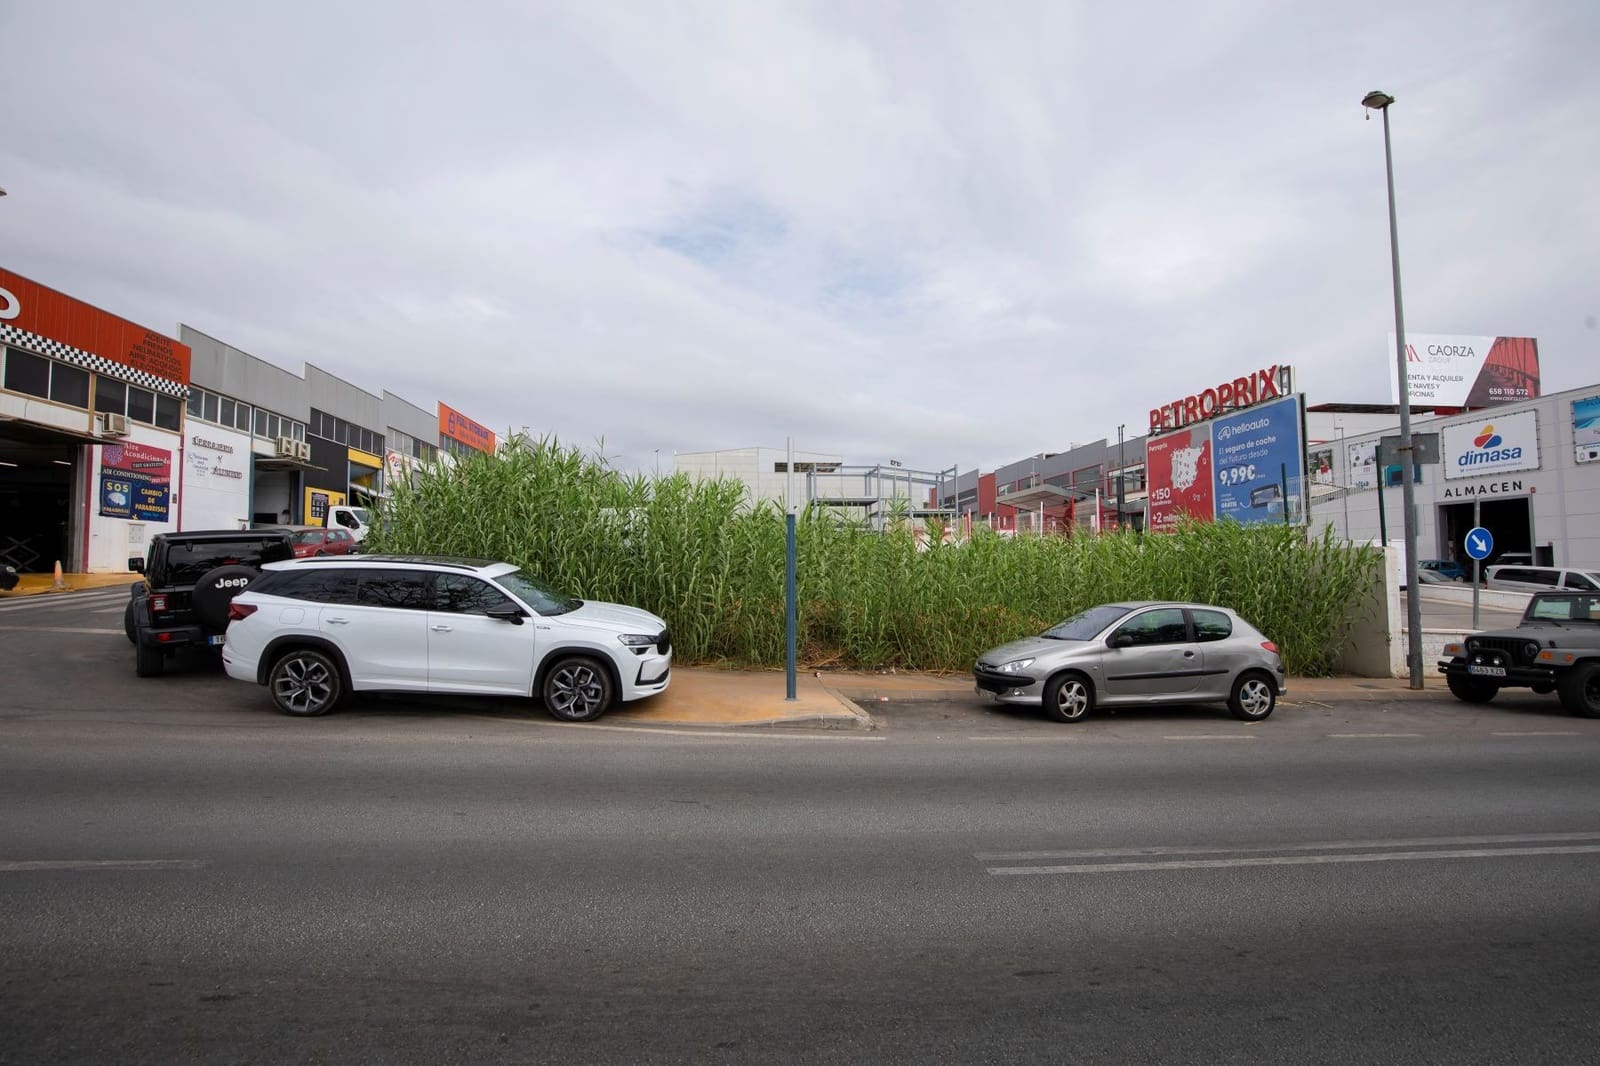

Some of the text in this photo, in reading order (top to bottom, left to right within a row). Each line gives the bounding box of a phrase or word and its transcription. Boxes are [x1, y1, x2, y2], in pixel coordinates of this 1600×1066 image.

[143, 339, 173, 356] FRENOS
[1427, 344, 1475, 357] CAORZA
[1149, 364, 1280, 430] PETROPRIX
[1231, 418, 1270, 436] helloauto
[124, 442, 139, 451] Aire
[1225, 443, 1246, 454] seguro
[1246, 440, 1255, 448] de
[1255, 436, 1277, 446] coche
[124, 450, 171, 465] Acondicionado
[1228, 453, 1248, 463] futuro
[1248, 447, 1268, 458] desde
[1458, 447, 1522, 466] dimasa
[112, 469, 152, 481] CONDITIONING
[1220, 464, 1256, 487] 9,99€
[140, 488, 163, 497] CAMBIO
[1151, 488, 1171, 500] +150
[1444, 480, 1523, 498] ALMACEN
[215, 577, 249, 590] Jeep
